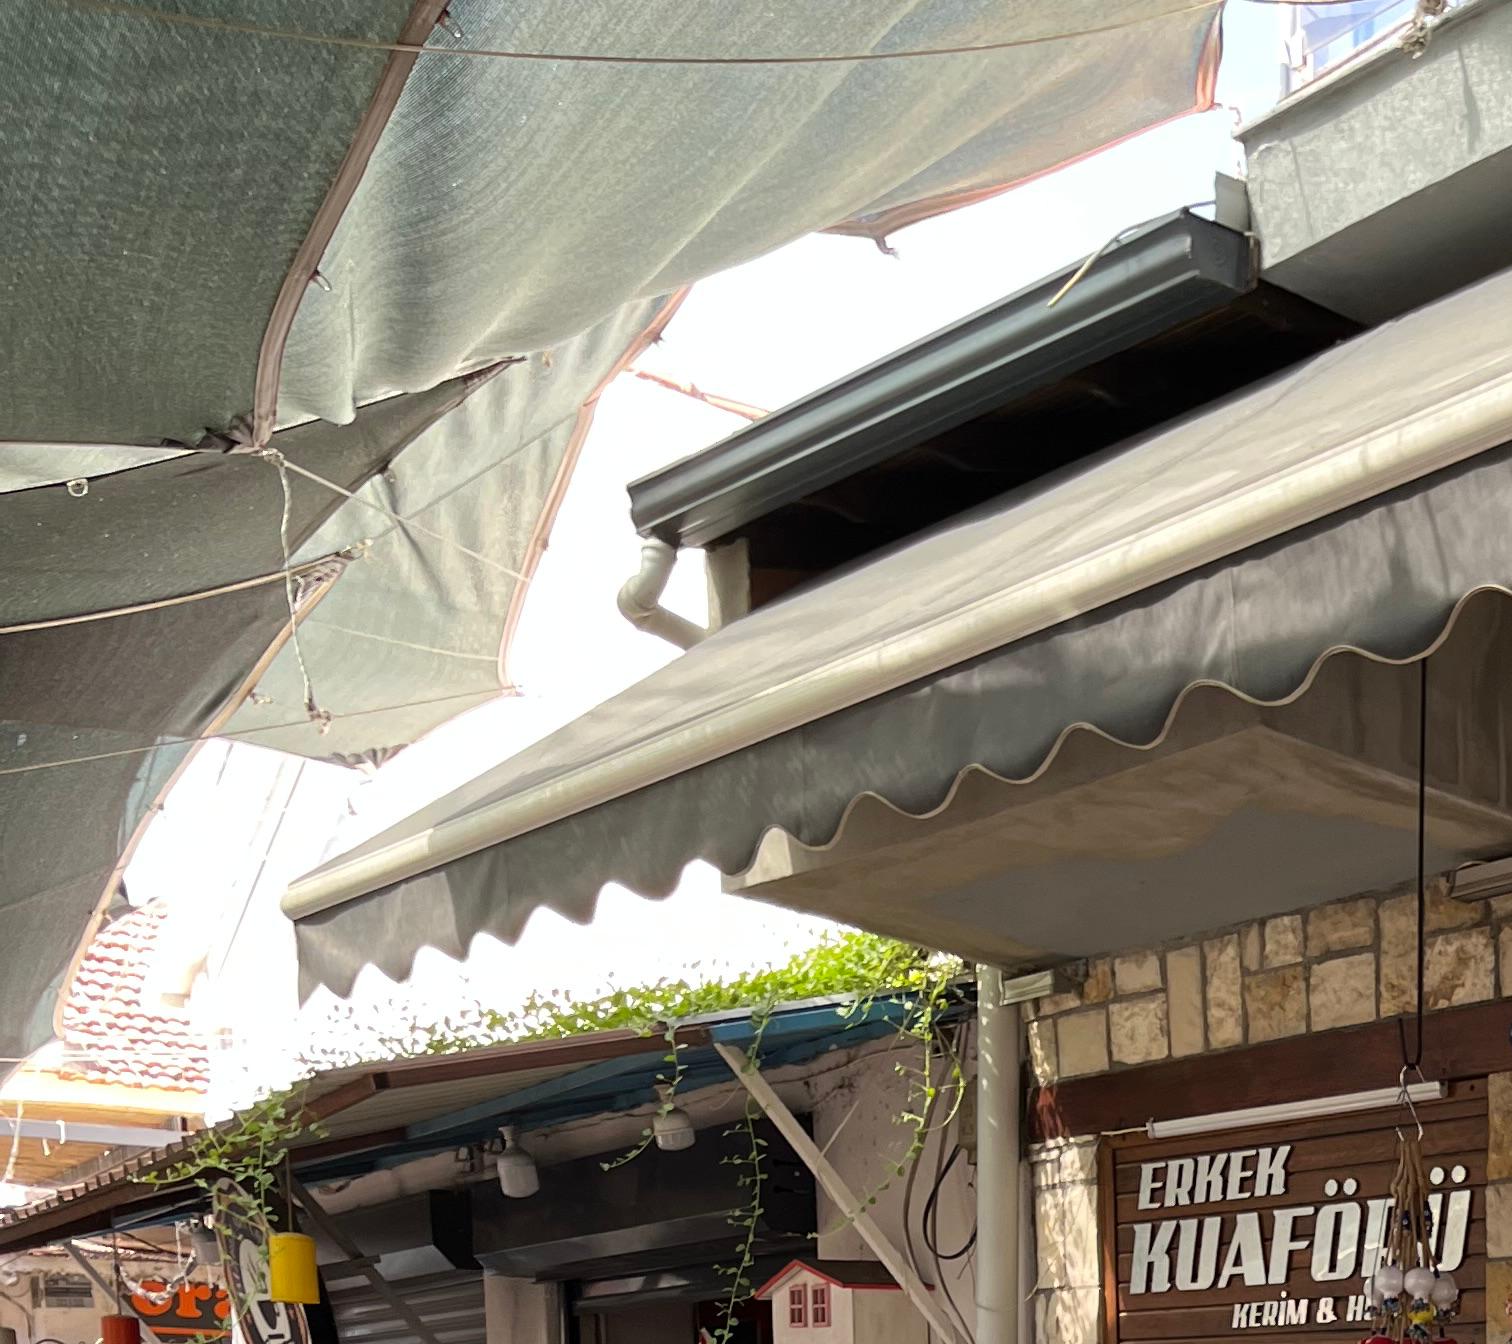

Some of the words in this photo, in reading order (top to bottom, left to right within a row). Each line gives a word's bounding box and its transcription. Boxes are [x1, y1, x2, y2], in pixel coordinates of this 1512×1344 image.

[1137, 1145, 1291, 1211] ERKEK
[1231, 1288, 1309, 1330] KERİM
[1316, 1296, 1338, 1325] &
